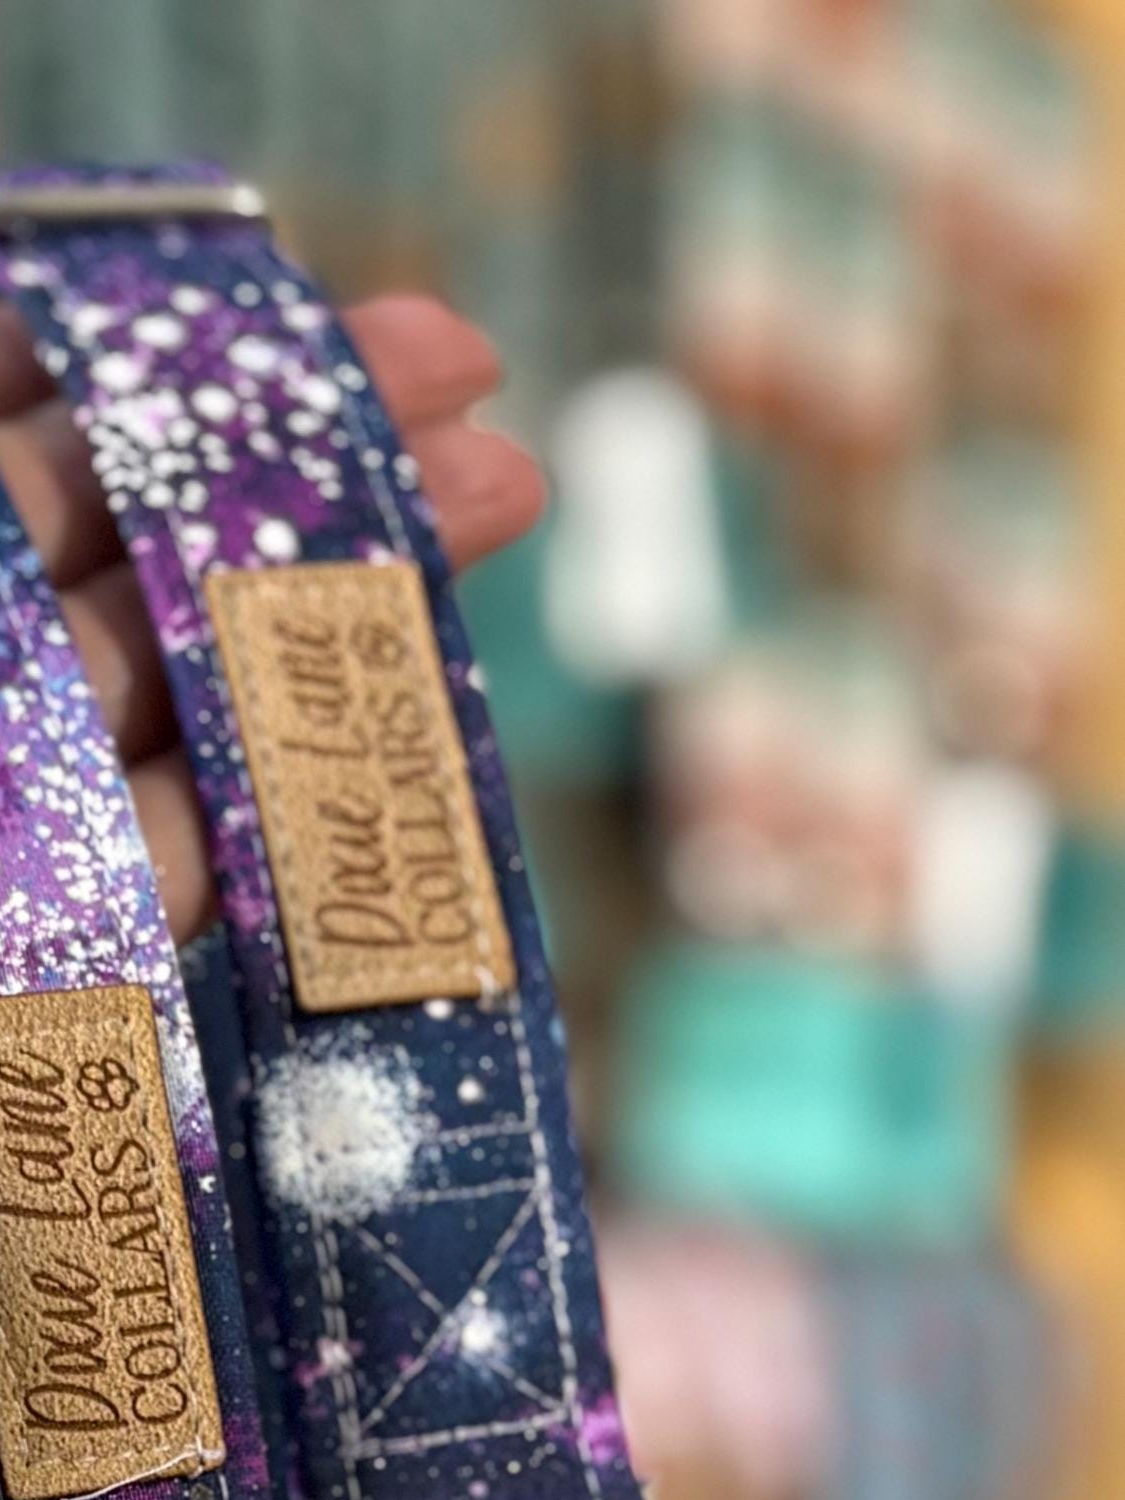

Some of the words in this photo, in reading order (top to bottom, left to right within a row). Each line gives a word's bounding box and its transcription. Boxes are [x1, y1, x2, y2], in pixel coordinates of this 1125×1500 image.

[273, 618, 370, 758] Lane
[315, 800, 416, 947] Dixie
[377, 690, 473, 945] COLLARS
[24, 1258, 128, 1431] Dixie
[91, 1138, 187, 1425] COLLARS
